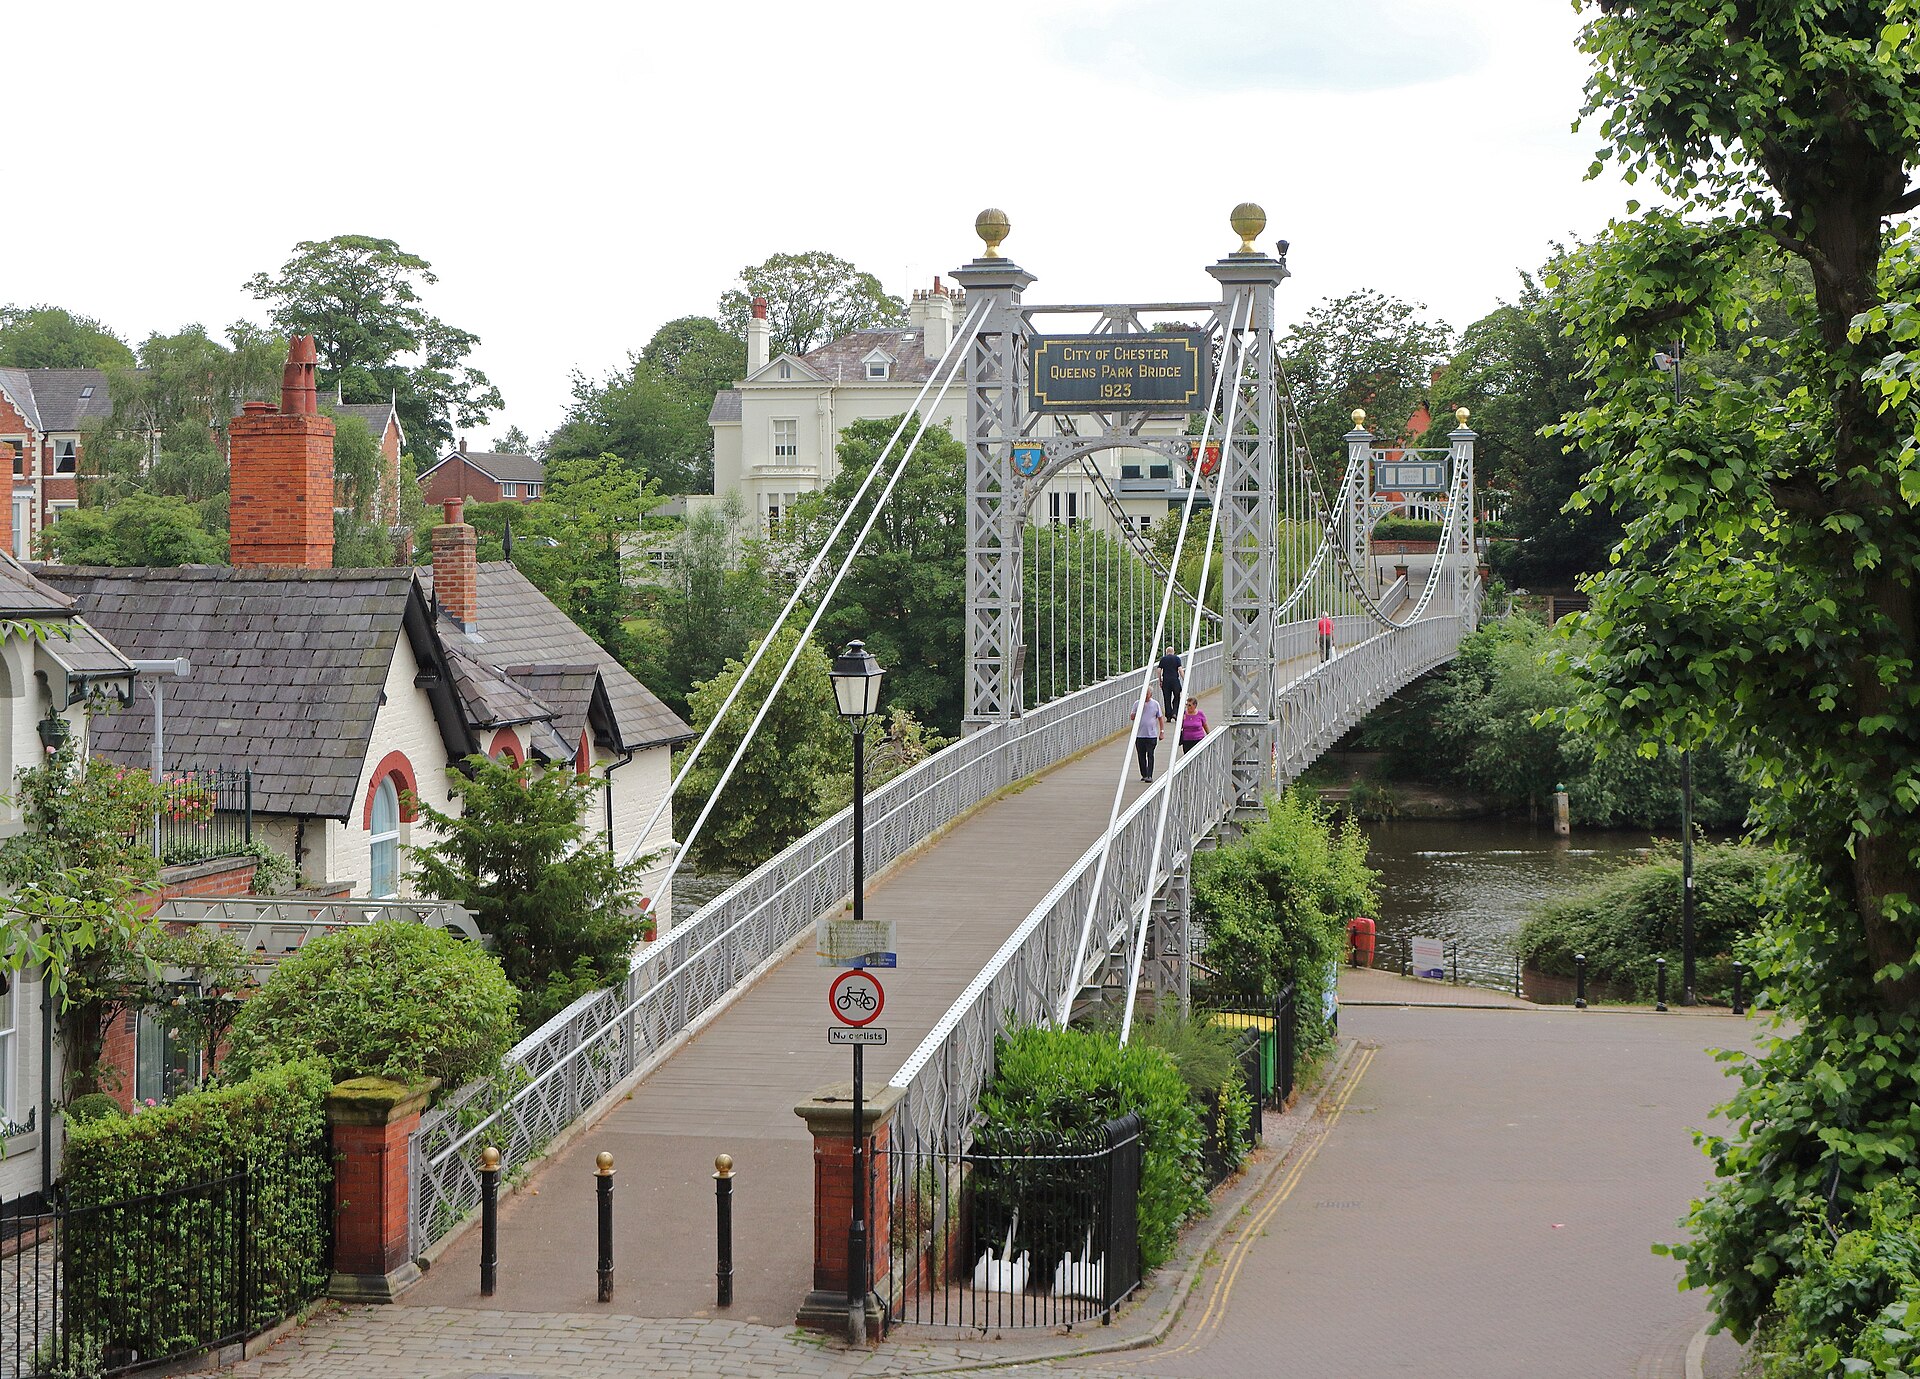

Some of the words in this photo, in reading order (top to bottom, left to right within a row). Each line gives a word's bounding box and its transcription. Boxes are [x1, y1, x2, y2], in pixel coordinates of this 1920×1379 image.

[1101, 364, 1133, 378] PARK
[1139, 364, 1182, 378] BRIDGE
[1100, 384, 1132, 398] 1923
